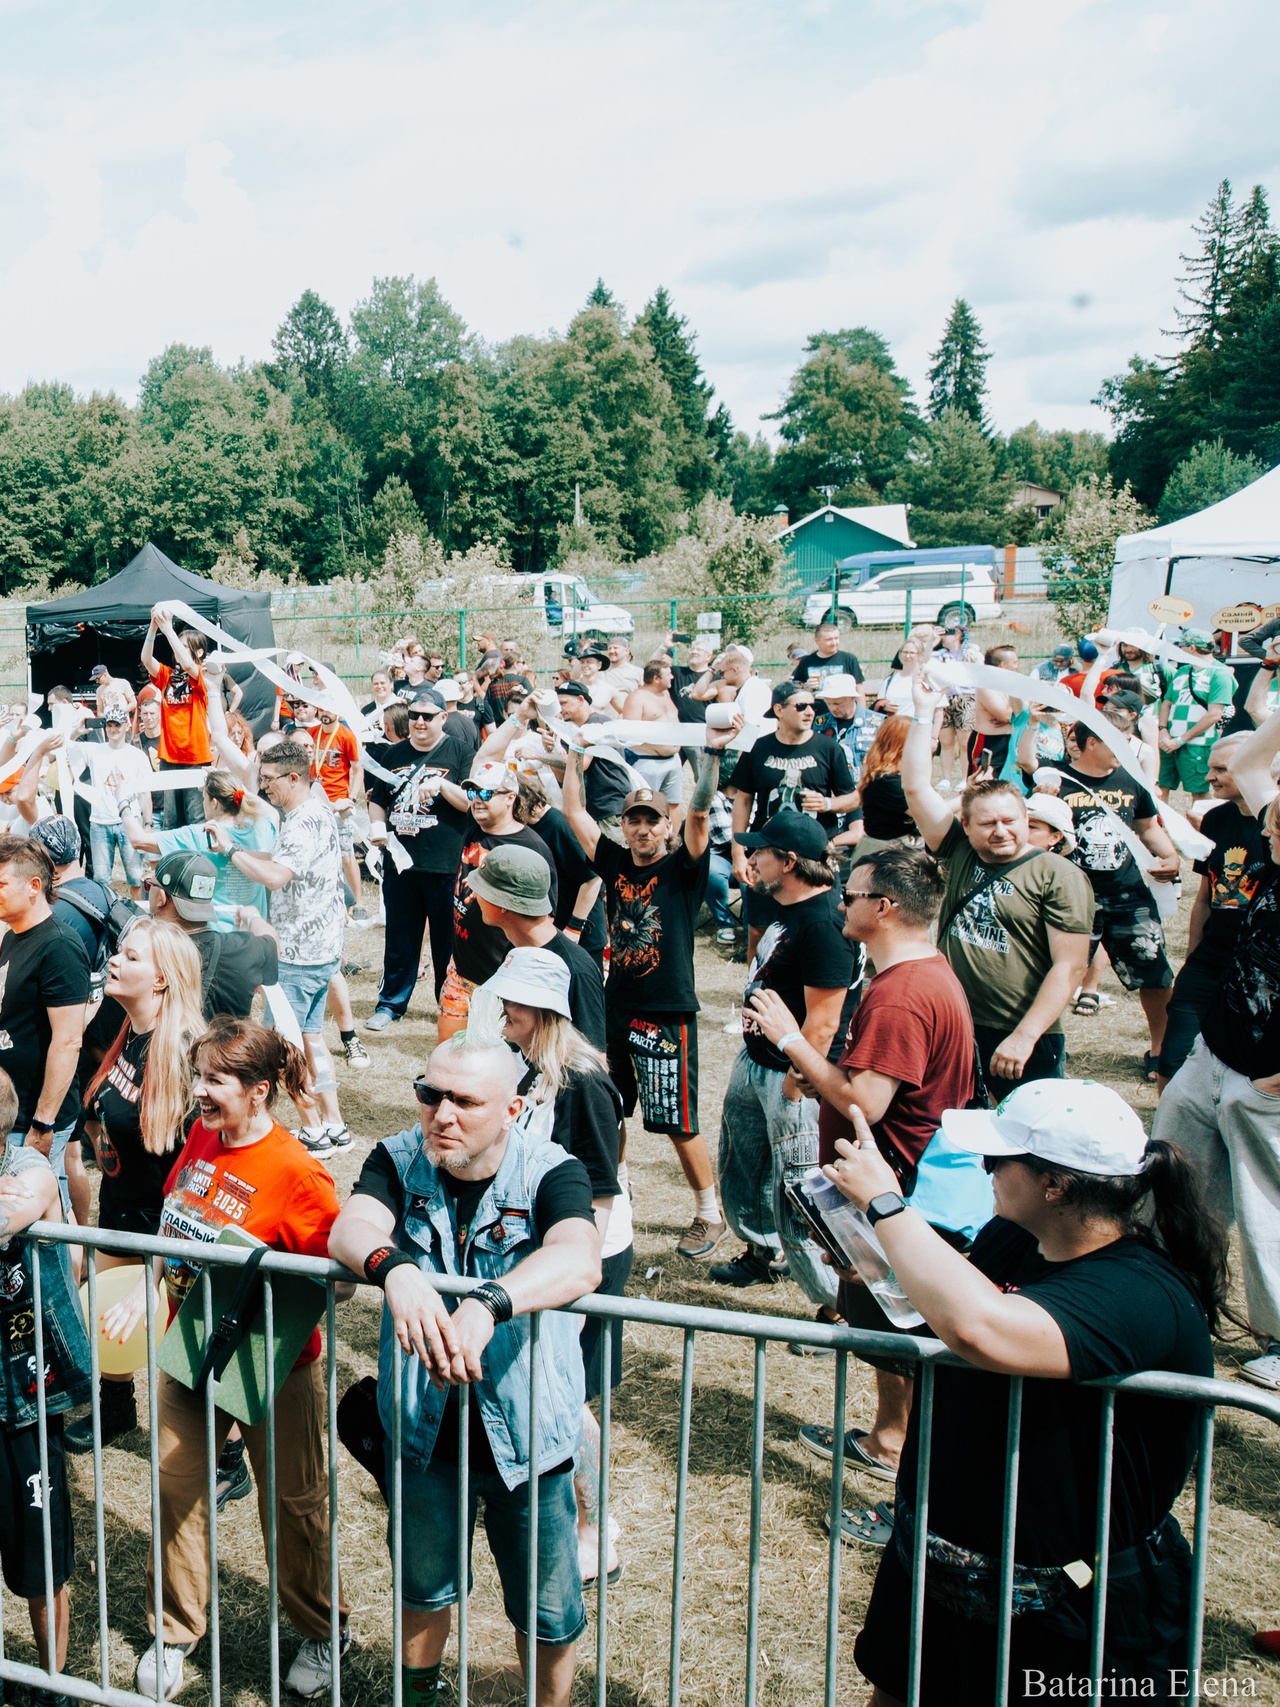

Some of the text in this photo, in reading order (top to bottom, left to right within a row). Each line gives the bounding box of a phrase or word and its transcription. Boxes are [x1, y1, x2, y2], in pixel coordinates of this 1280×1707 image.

[1218, 617, 1256, 625] стойкий
[1221, 609, 1254, 618] Самый
[974, 923, 1009, 944] FINE
[628, 1031, 657, 1050] PARTY
[186, 1181, 209, 1198] PARTY
[213, 1189, 247, 1220] 2025
[163, 1209, 216, 1244] ГЛАВНЫЙ
